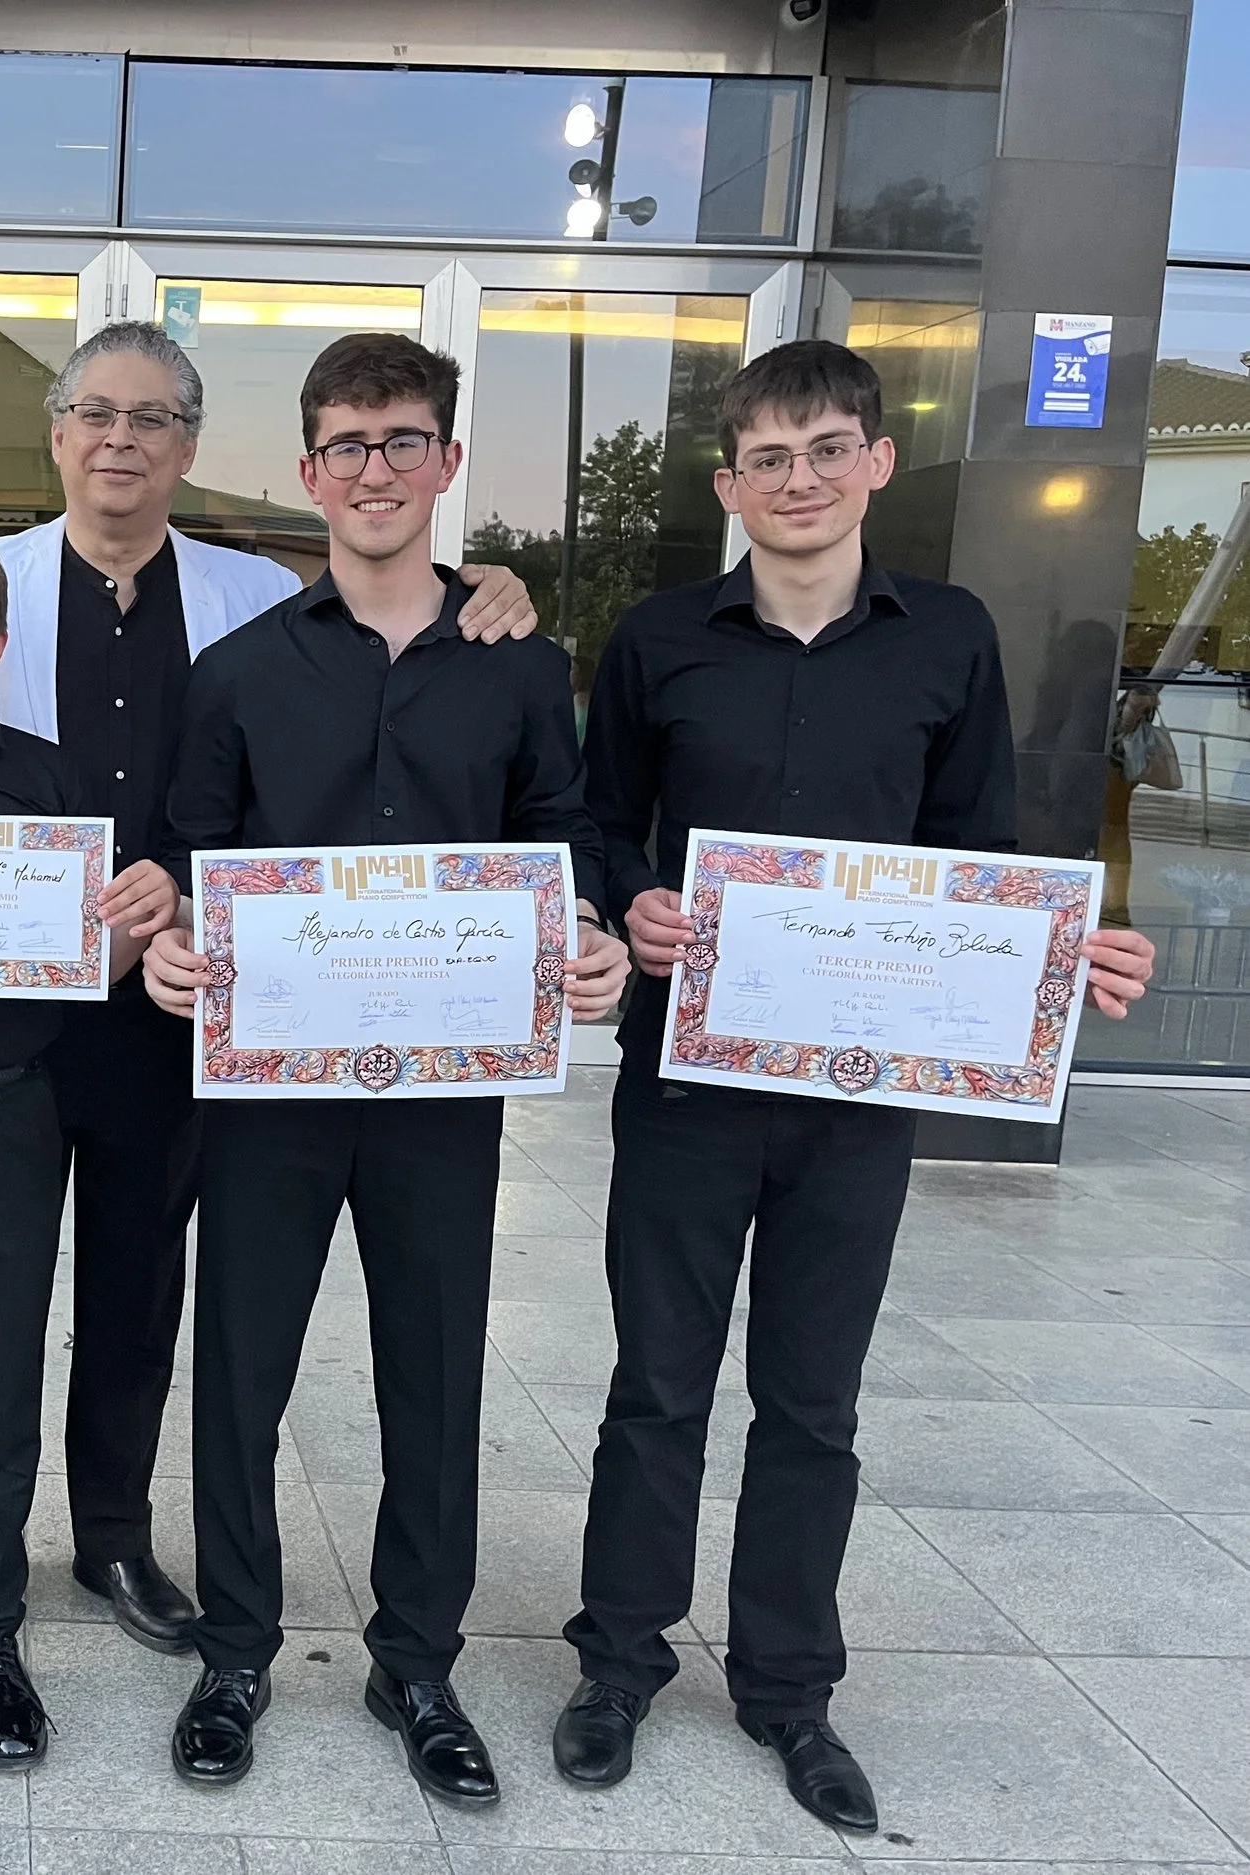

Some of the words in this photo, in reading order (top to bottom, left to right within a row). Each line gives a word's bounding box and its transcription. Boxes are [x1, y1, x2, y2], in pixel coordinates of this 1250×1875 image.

[858, 890, 910, 899] INTERNATIONAL
[857, 895, 881, 903] PIANO
[882, 898, 934, 908] COMPETITION
[752, 906, 856, 938] Fernando
[282, 911, 374, 955] Alejandro
[382, 920, 400, 939] de
[405, 919, 446, 939] Castro
[455, 917, 515, 952] García
[330, 957, 382, 968] PRIMER
[386, 956, 439, 967] PREMIO
[816, 954, 873, 969] TERCER
[876, 960, 934, 975] PREMIO
[318, 970, 374, 980] CATEGORÍA
[375, 971, 409, 980] JOVEN
[410, 971, 451, 979] ARTISTA
[802, 967, 861, 980] CATEGORÍA
[862, 973, 898, 984] JOVEN
[899, 977, 943, 988] ARTISTA
[852, 991, 886, 1000] JURADO
